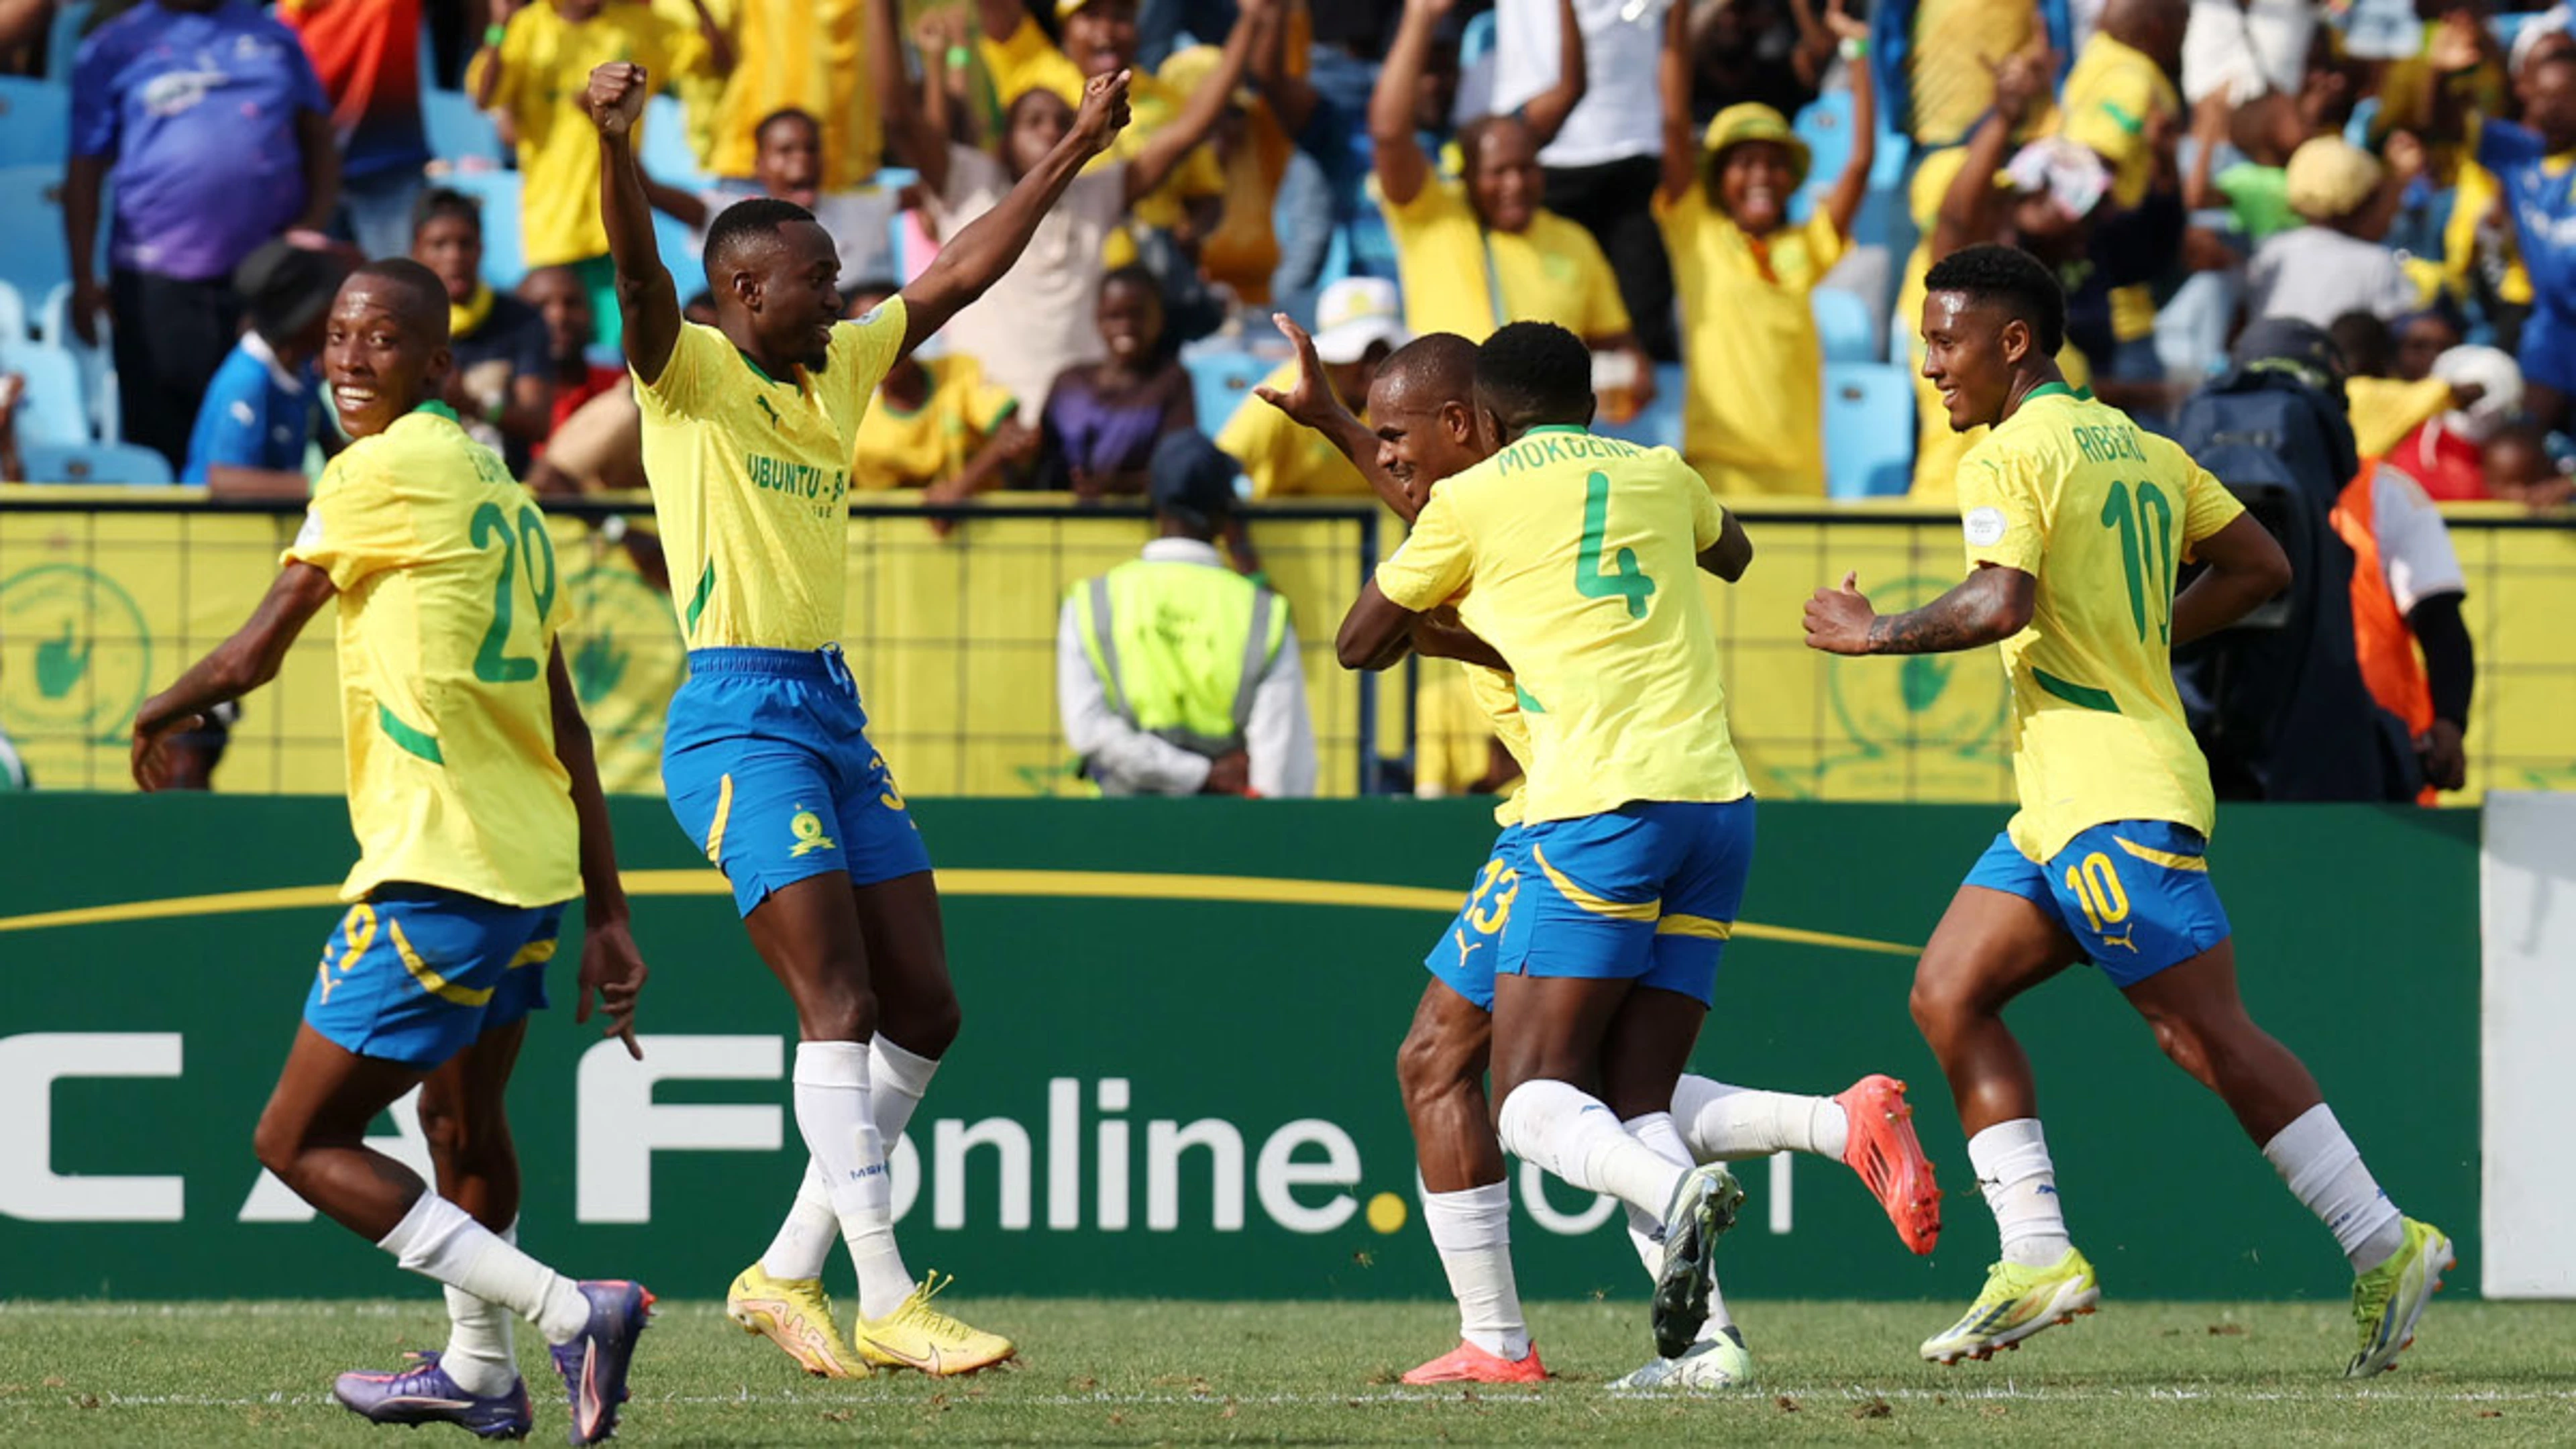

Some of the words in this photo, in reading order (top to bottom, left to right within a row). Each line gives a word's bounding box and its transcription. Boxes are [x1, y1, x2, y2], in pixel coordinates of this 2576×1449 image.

[747, 452, 821, 498] UBUNTU
[1576, 471, 1656, 619] 4
[2101, 480, 2171, 645] 10
[2066, 851, 2129, 932] 10
[324, 903, 378, 972] 9
